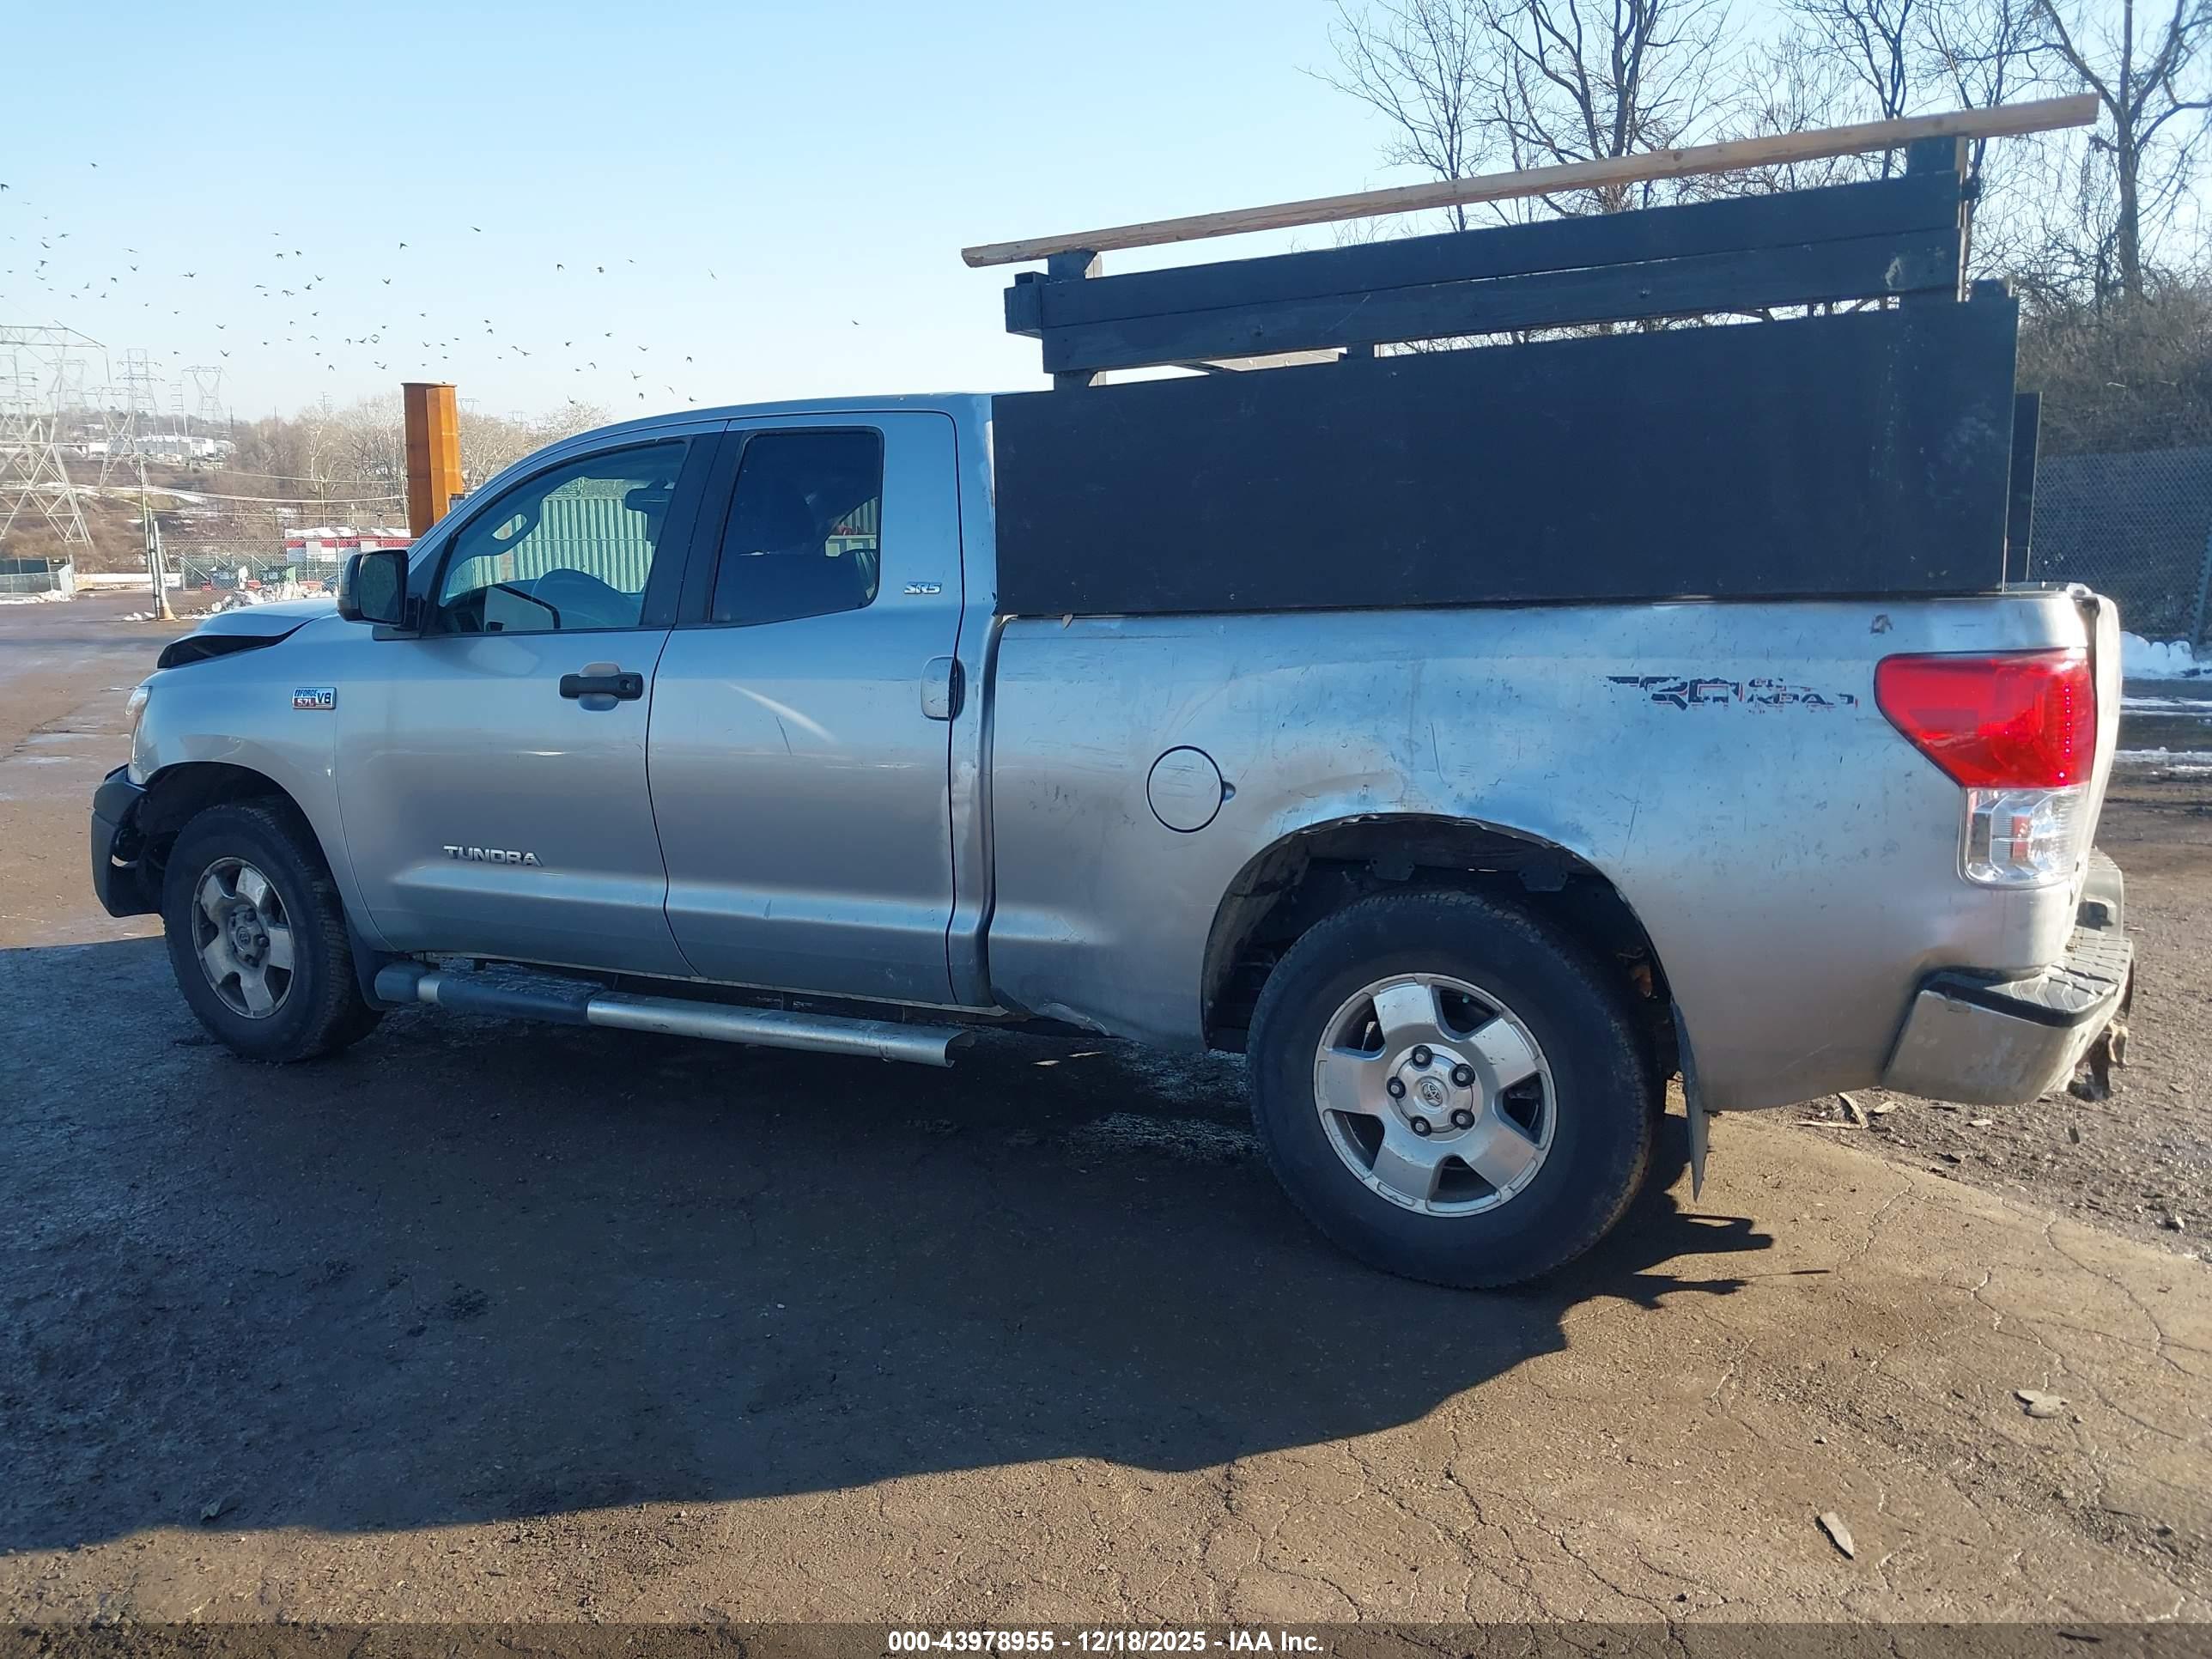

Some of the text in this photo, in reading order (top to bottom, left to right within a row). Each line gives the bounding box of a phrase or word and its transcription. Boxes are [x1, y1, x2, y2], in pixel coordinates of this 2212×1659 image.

[903, 582, 942, 594] SR5
[317, 691, 332, 704] V8
[443, 845, 544, 866] TUNDRA
